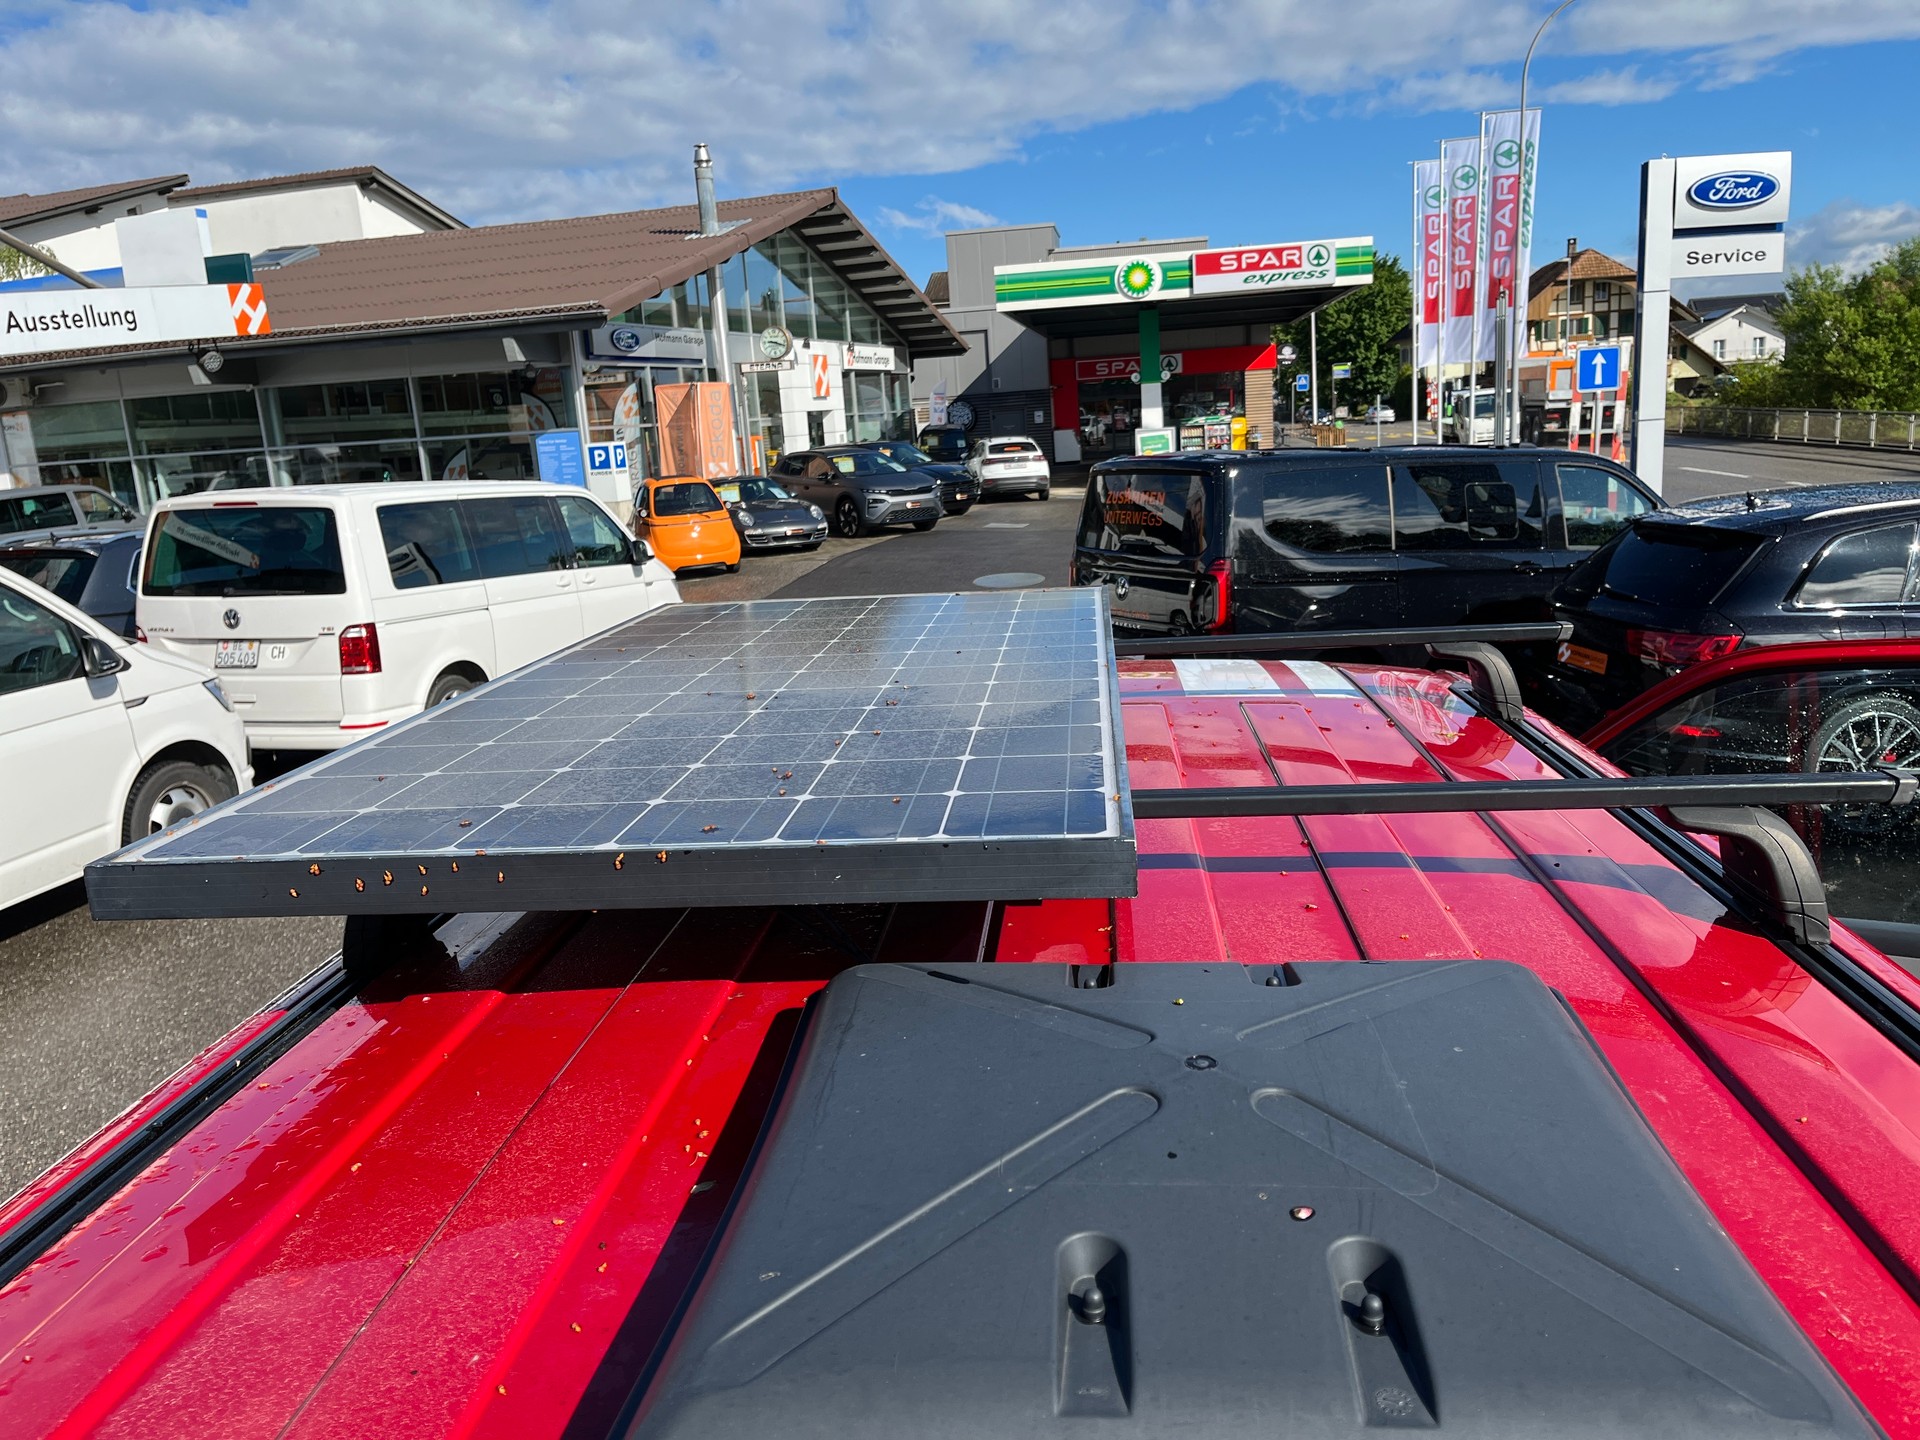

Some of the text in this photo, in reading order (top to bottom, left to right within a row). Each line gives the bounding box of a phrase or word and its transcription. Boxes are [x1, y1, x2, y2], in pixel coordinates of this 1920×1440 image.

[1521, 138, 1535, 250] express
[1708, 177, 1764, 201] Ford
[1493, 176, 1516, 280] SPAR
[1454, 196, 1473, 290] SPAR
[1219, 250, 1301, 271] SPAR
[1427, 214, 1440, 299] SPAR
[1686, 249, 1767, 266] Service
[1242, 269, 1330, 285] express
[6, 304, 138, 334] Ausstellung
[683, 334, 704, 347] Garage
[750, 362, 783, 371] ETERNA
[1095, 361, 1140, 375] SPA
[594, 449, 606, 467] P
[616, 448, 624, 466] P
[1106, 490, 1166, 506] ZUSAMMEN
[1104, 510, 1163, 527] UNTERWEGS
[1112, 621, 1142, 630] AVELLE
[233, 640, 244, 651] BE
[271, 646, 286, 659] CH
